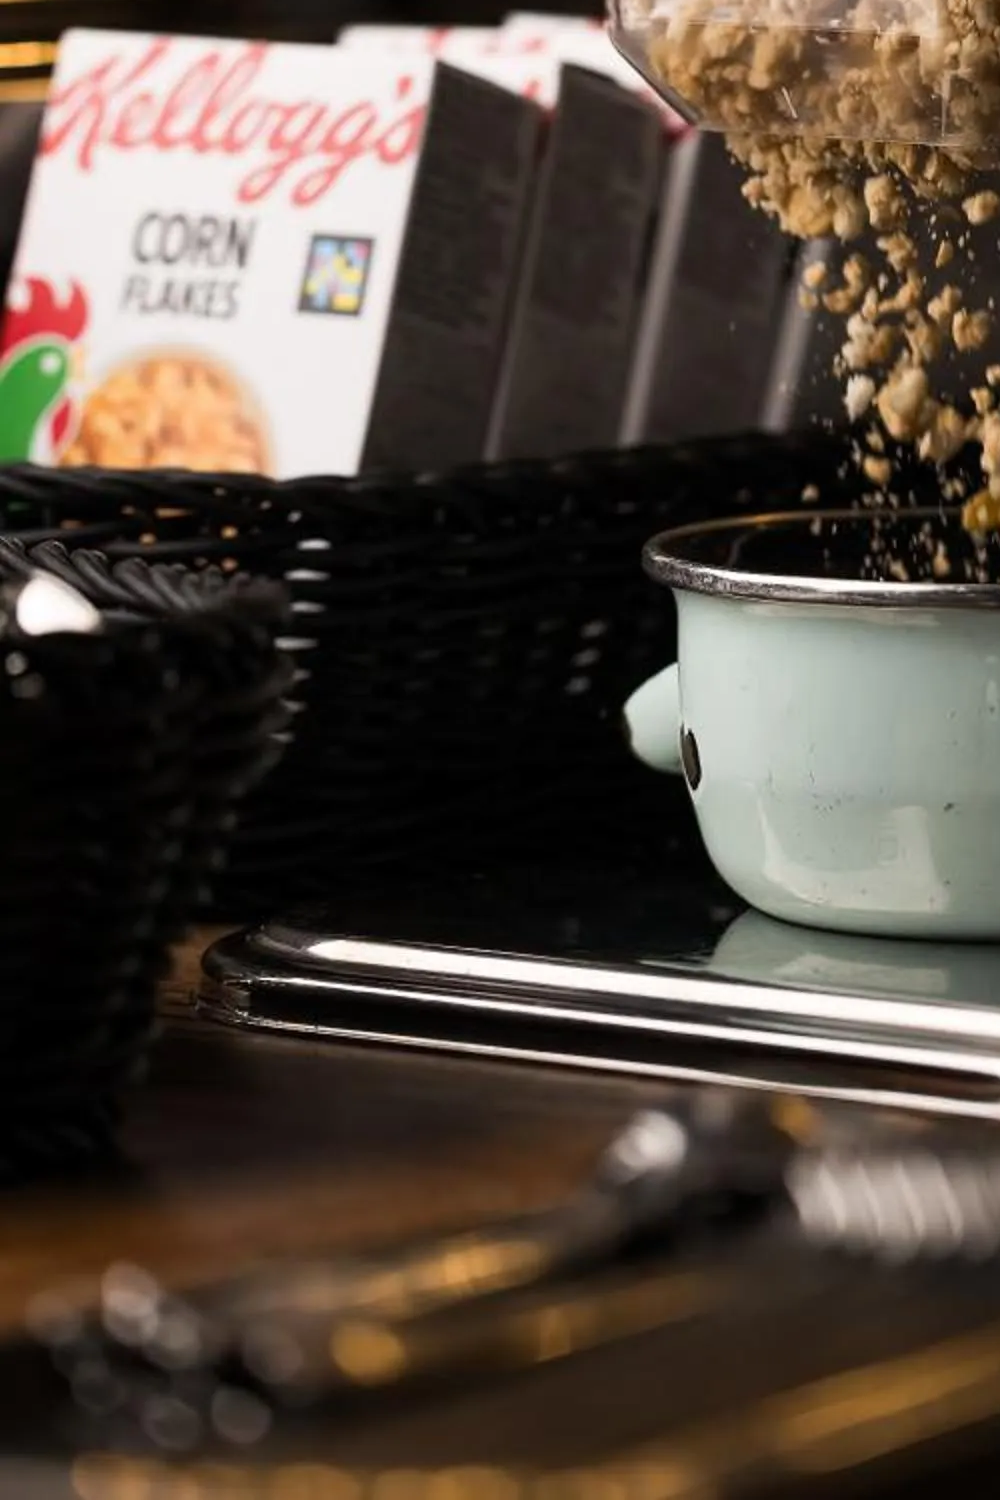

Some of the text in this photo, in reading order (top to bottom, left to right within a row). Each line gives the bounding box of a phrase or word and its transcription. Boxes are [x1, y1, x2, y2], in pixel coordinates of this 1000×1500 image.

[40, 35, 425, 205] Kellogg's
[133, 211, 256, 267] CORN
[119, 274, 240, 318] FLAKES
